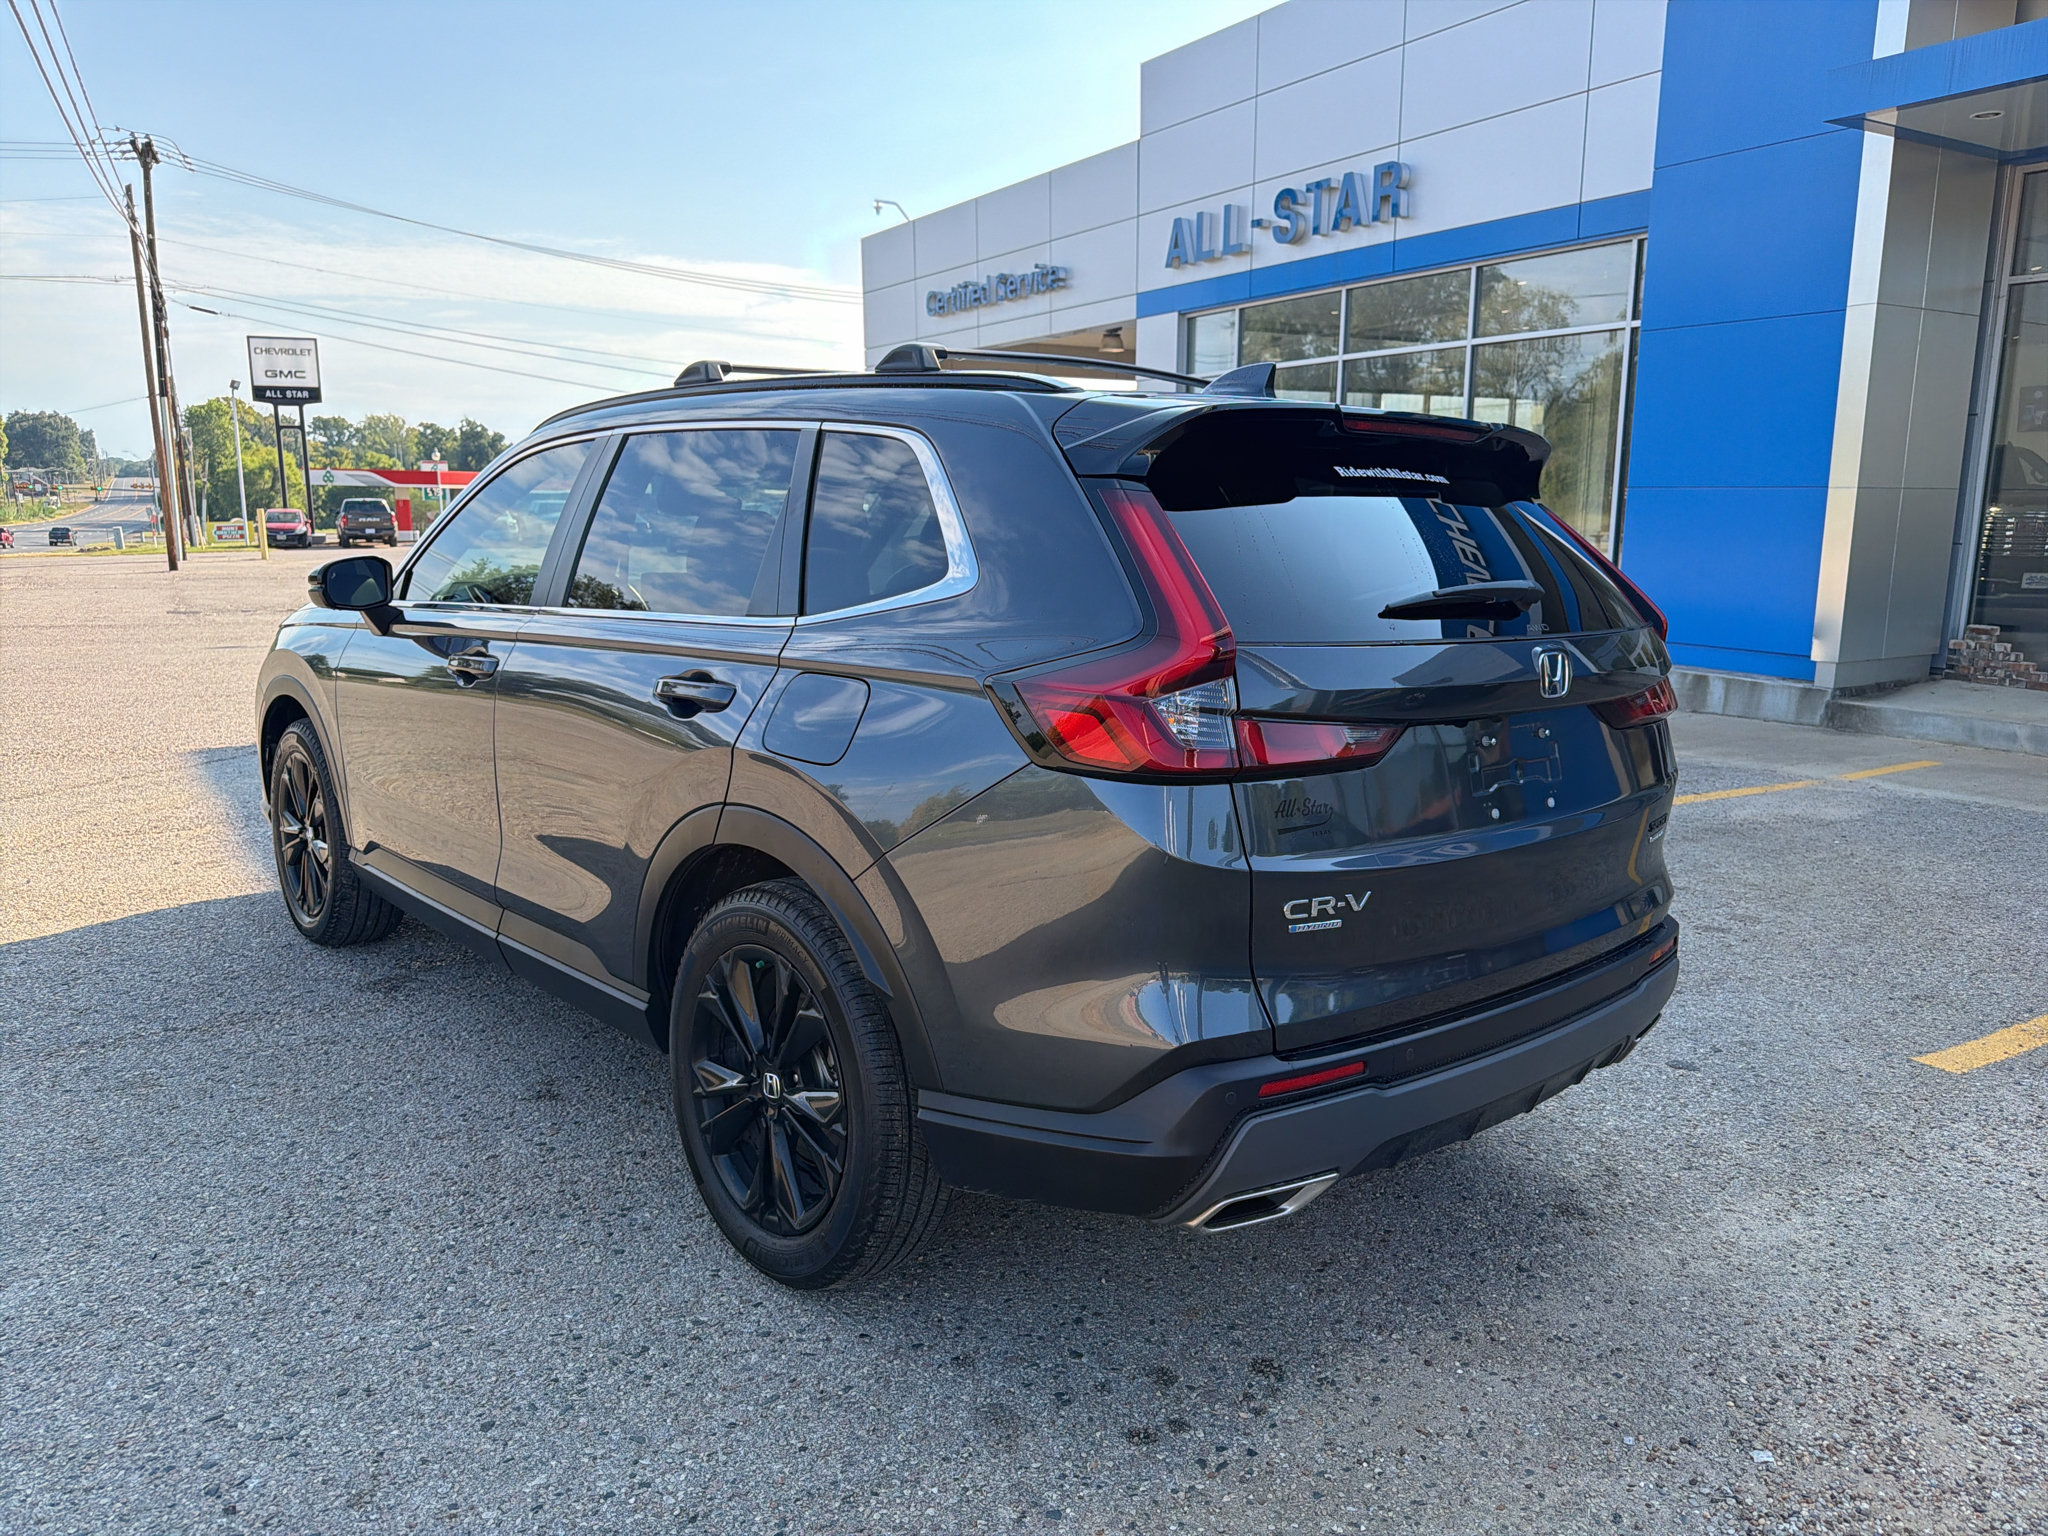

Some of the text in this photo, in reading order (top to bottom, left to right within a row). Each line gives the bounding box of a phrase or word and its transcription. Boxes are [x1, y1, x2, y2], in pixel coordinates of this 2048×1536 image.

[1165, 161, 1410, 269] ALL-STAR
[926, 263, 1067, 317] Certified Service
[254, 346, 312, 357] CHEVROLET
[264, 369, 307, 379] GMC
[265, 389, 309, 399] ALL STAR
[1526, 623, 1550, 631] AWD
[1283, 890, 1371, 920] CR-V
[1296, 920, 1341, 932] HYBRID
[712, 916, 810, 963] MICHELIN PRIMACY
